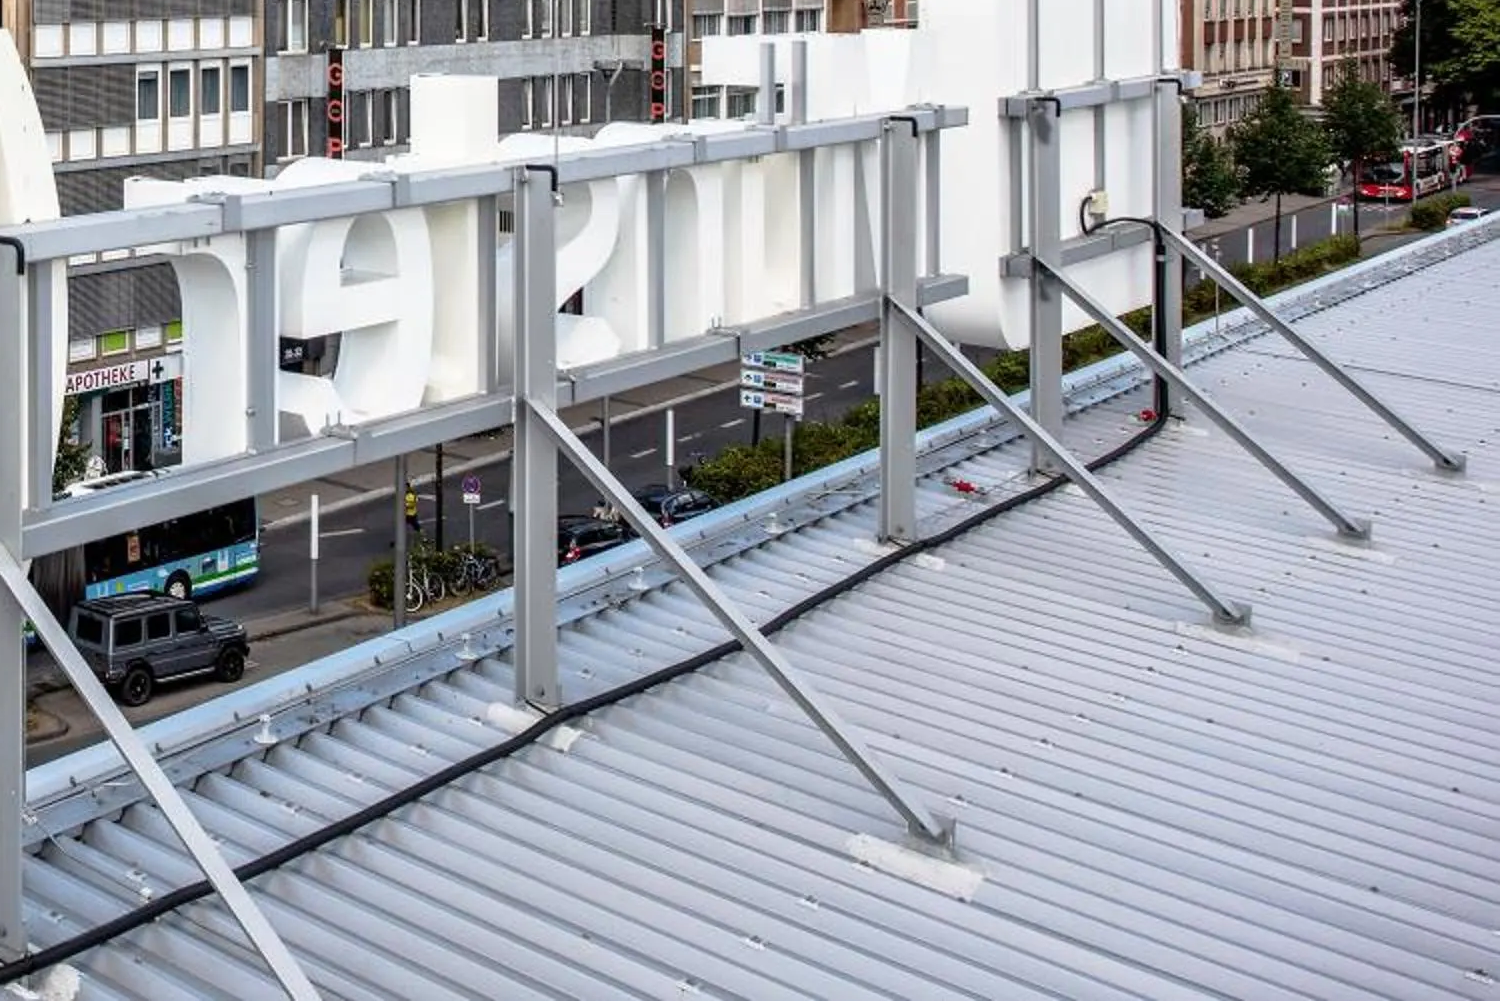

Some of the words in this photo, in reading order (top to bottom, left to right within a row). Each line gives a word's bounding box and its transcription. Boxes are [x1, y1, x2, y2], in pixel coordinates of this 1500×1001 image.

[327, 63, 344, 159] GOP
[651, 41, 667, 119] GOP
[66, 364, 135, 394] APOTHEKE
